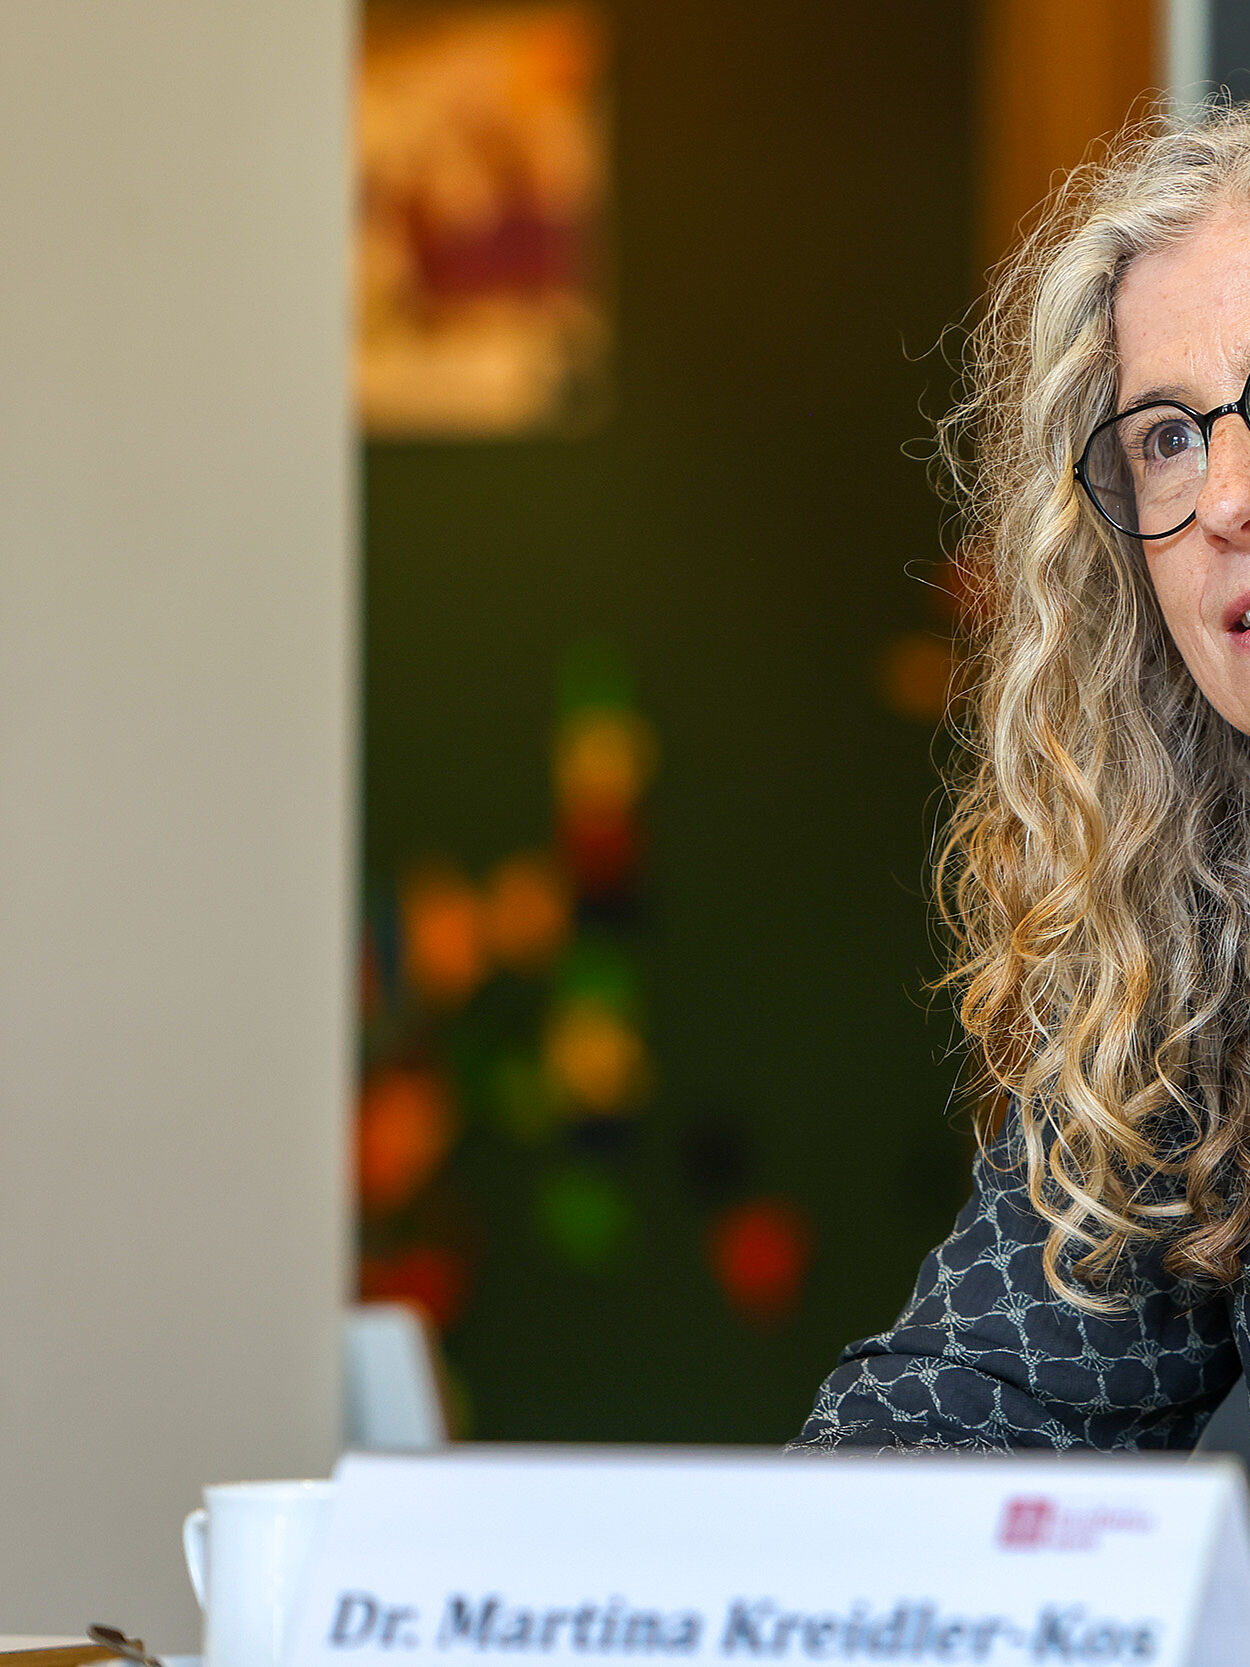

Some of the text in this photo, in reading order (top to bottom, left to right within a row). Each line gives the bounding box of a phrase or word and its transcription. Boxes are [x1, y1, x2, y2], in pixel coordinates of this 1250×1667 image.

[328, 1591, 1160, 1660] Dr. Martina Kreidler-Kos
